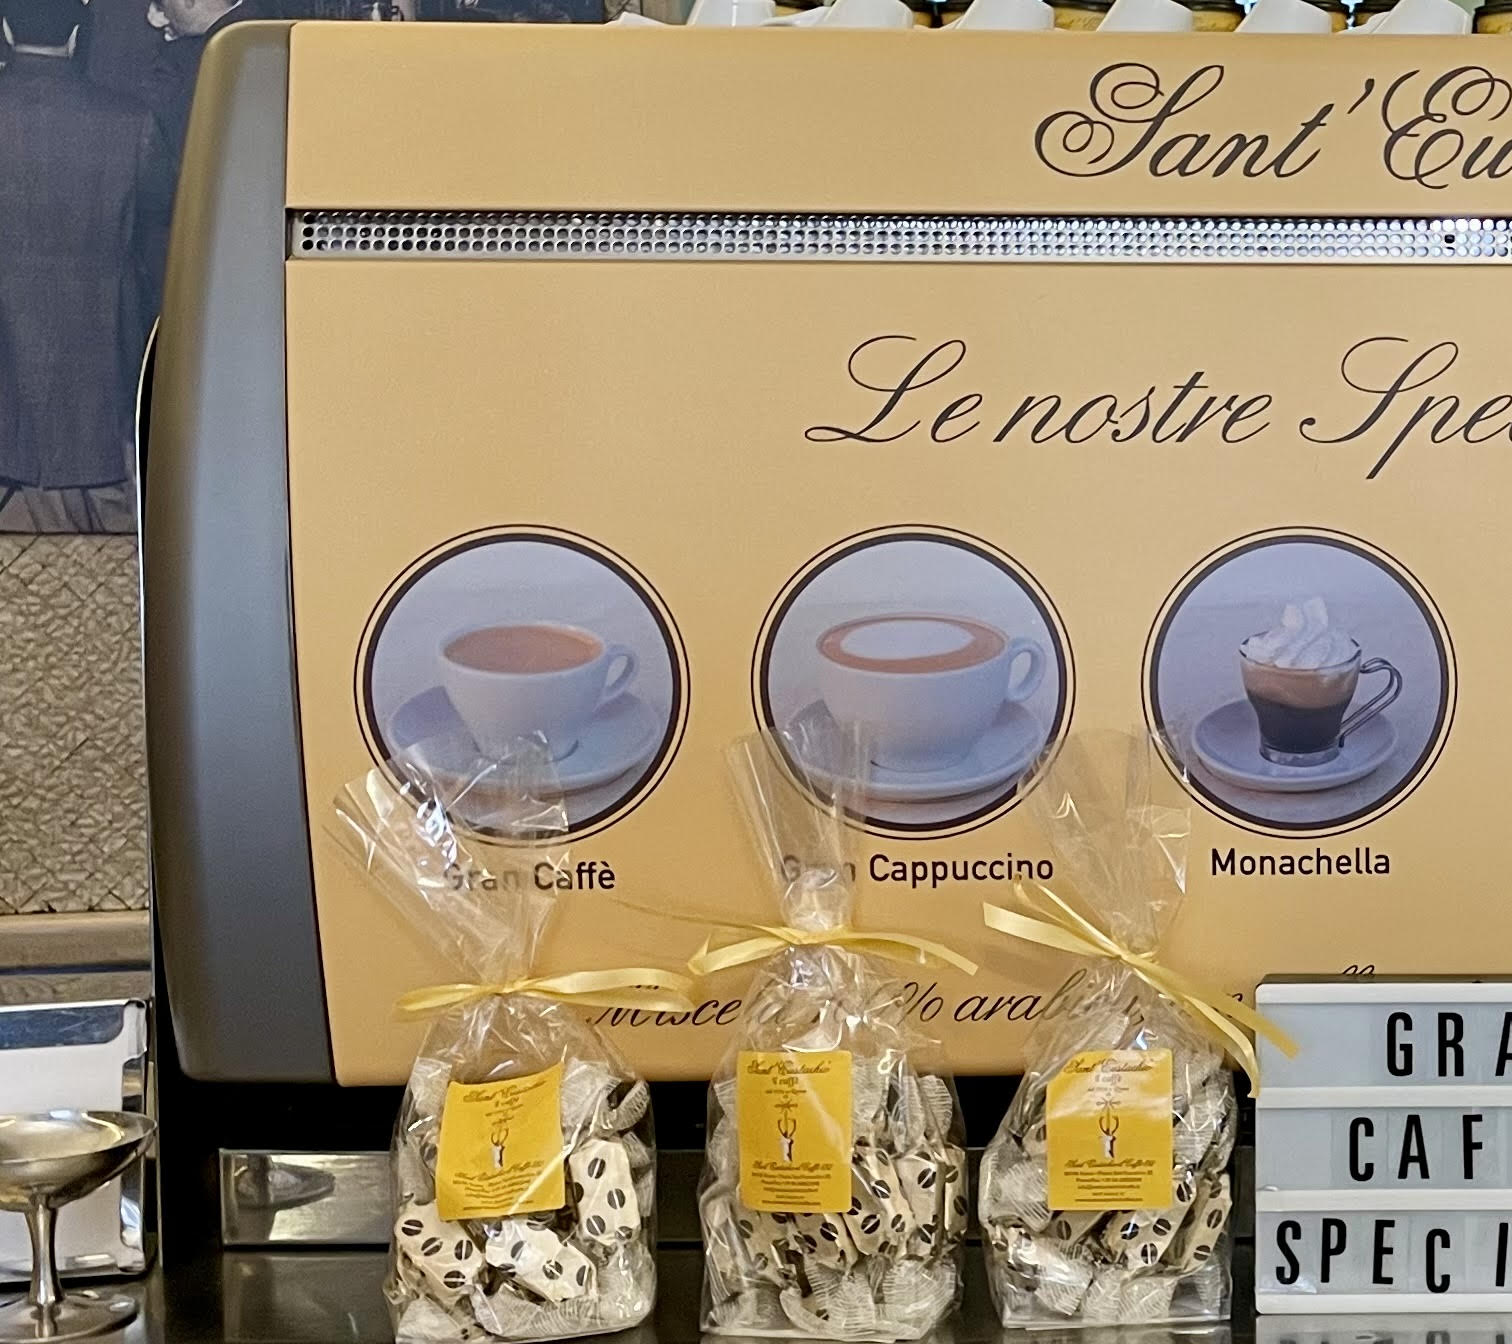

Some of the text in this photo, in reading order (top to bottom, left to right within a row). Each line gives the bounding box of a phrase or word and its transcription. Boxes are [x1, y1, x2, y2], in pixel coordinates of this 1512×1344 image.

[803, 334, 981, 446] Le
[991, 369, 1272, 447] nostre
[533, 860, 616, 891] Caffè
[868, 852, 1054, 889] Cappuccino
[1211, 847, 1391, 876] Monachella
